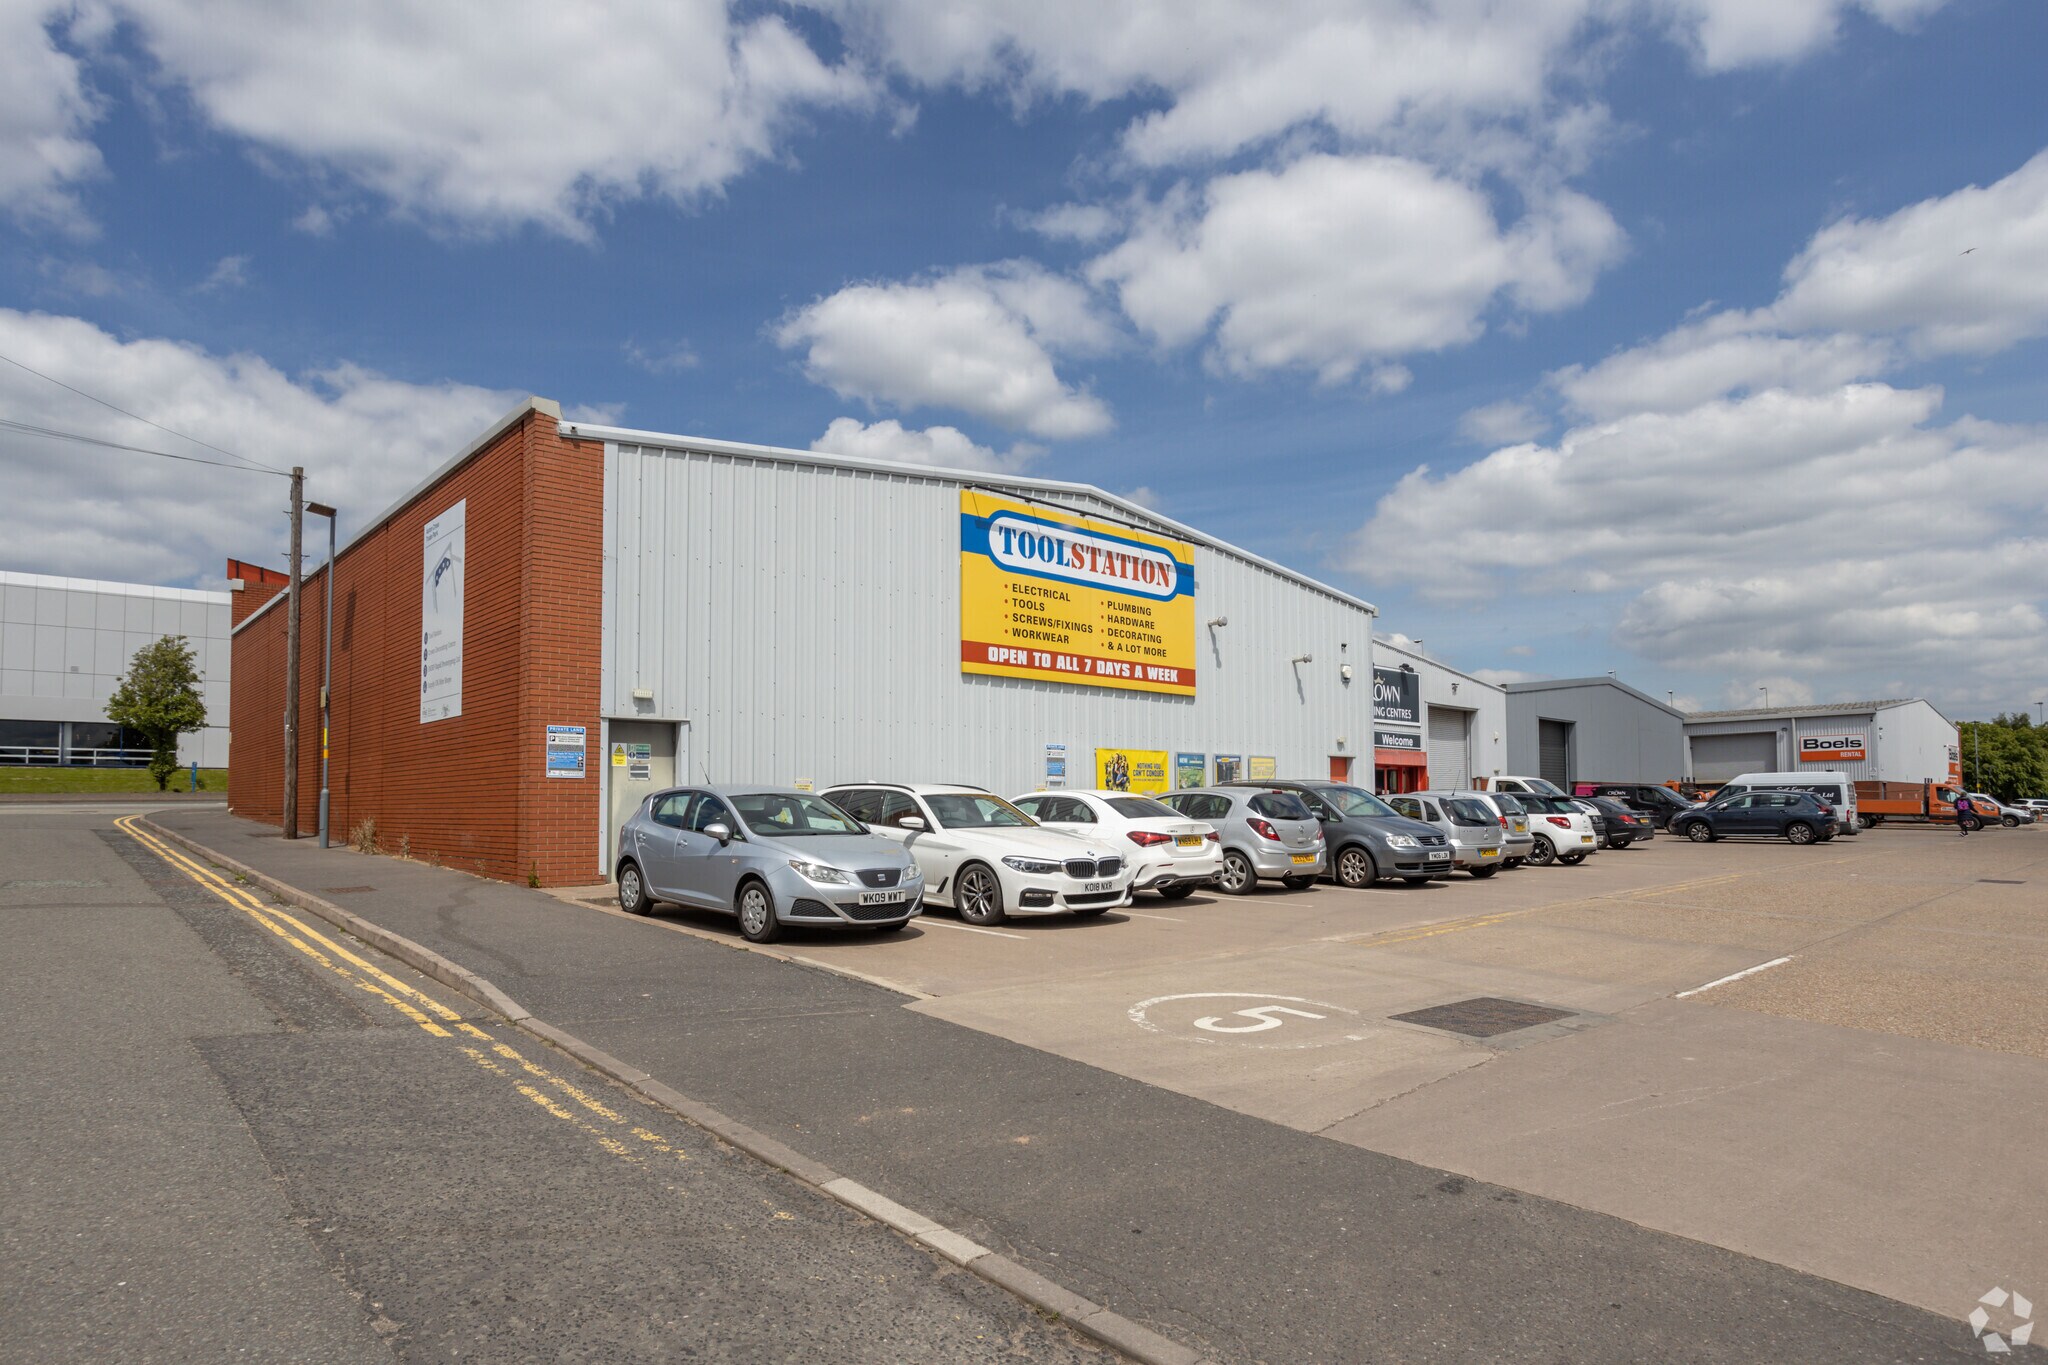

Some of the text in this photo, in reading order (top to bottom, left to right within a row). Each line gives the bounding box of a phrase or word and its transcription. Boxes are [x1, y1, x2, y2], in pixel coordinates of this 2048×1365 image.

[998, 525, 1171, 588] TOOLSTATION
[1012, 583, 1071, 602] ELECTRICAL
[1012, 597, 1045, 611] TOOLS
[1107, 601, 1152, 616] PLUMBING
[1012, 612, 1093, 633] SCREWS/FIXINGS
[1107, 614, 1155, 630] HARDWARE
[1012, 627, 1069, 644] WORKWEAR
[1107, 627, 1162, 644] DECORATING
[1107, 641, 1167, 658] & A LOT MORE
[988, 646, 1178, 682] OPEN TO ALL 7 DAYS A WEEK
[1373, 683, 1400, 703] OWN
[1386, 707, 1412, 719] CENTRES
[1382, 733, 1414, 747] Welcome
[1803, 737, 1862, 750] Boels
[1101, 881, 1113, 890] NXR
[863, 893, 886, 904] WK09
[1193, 1005, 1328, 1033] 5
